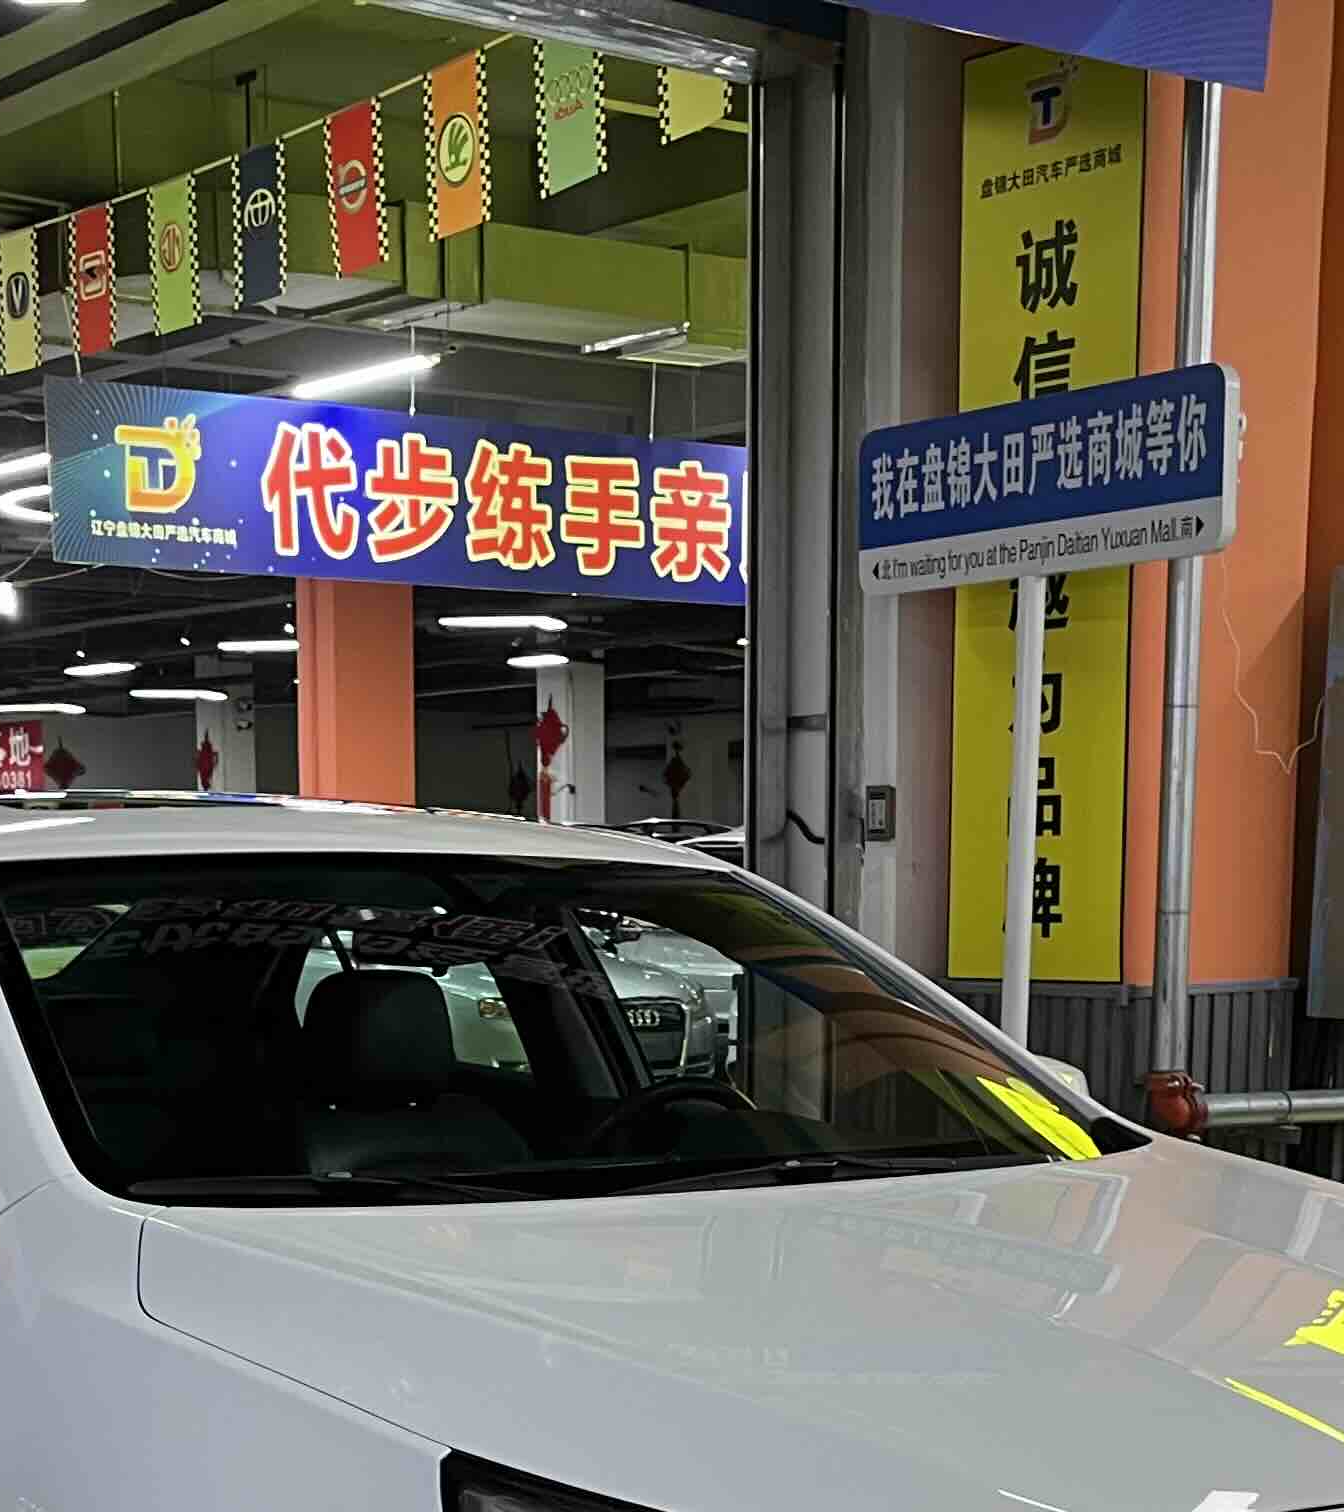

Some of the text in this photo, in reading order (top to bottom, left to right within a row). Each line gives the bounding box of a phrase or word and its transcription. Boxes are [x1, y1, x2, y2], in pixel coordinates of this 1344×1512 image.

[979, 143, 1124, 200] 盘锦大田汽车严选商城
[262, 422, 747, 582] 代步练手亲
[871, 394, 1207, 521] 我在盘锦大田严选商城等你
[910, 551, 946, 579] waiting
[962, 551, 984, 576] you
[999, 542, 1017, 565] the
